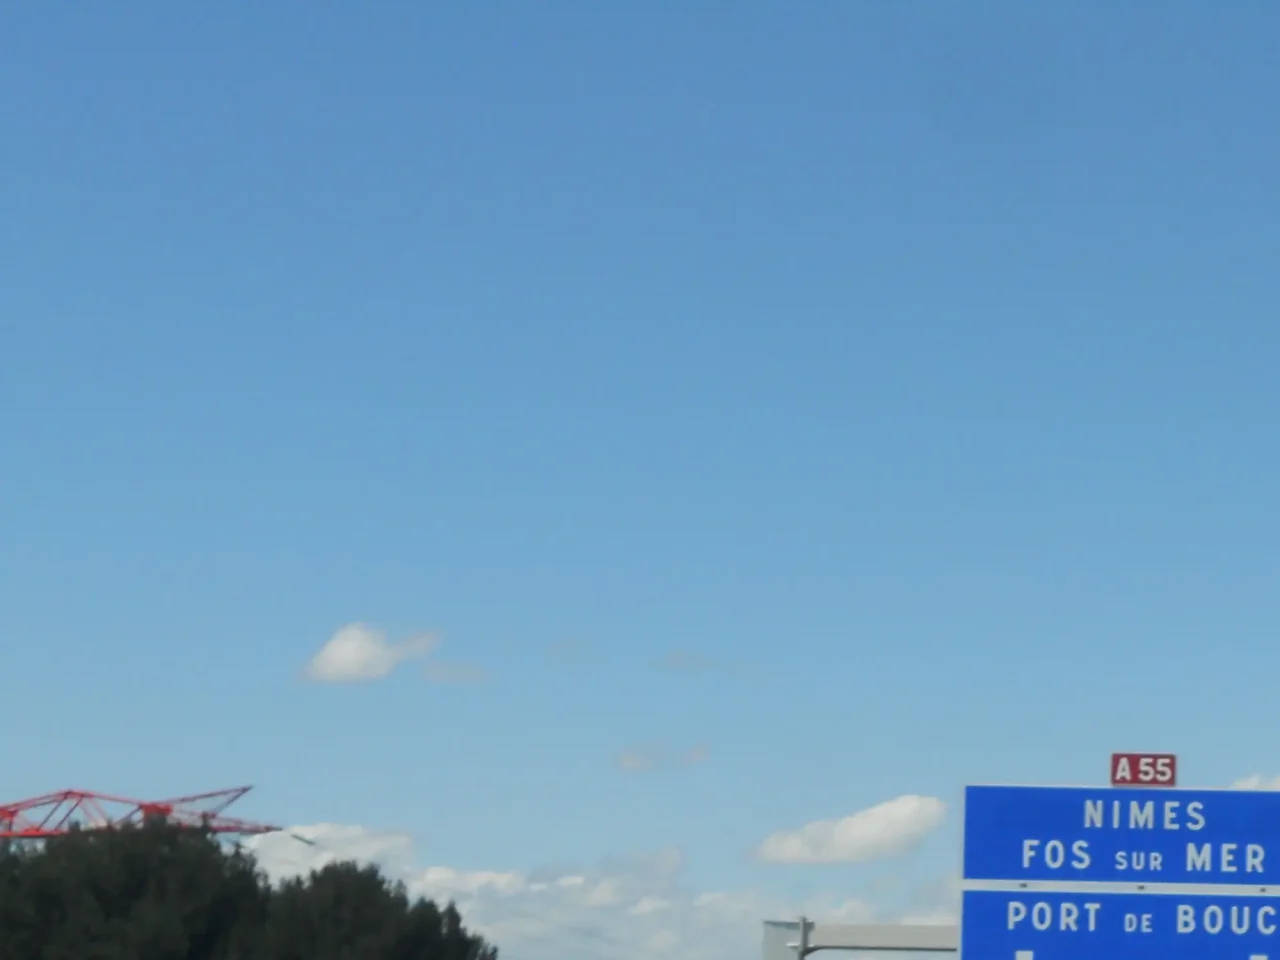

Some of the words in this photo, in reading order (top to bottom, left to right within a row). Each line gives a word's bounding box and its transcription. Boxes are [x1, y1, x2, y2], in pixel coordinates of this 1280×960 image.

[1115, 757, 1131, 781] A
[1138, 758, 1173, 782] 55
[1084, 800, 1206, 830] NIMES
[1022, 839, 1091, 869] FOS
[1114, 851, 1163, 870] SUR
[1186, 843, 1266, 873] MER
[1007, 901, 1101, 931] PORT
[1124, 913, 1153, 933] DE
[1176, 904, 1278, 935] BOUC
